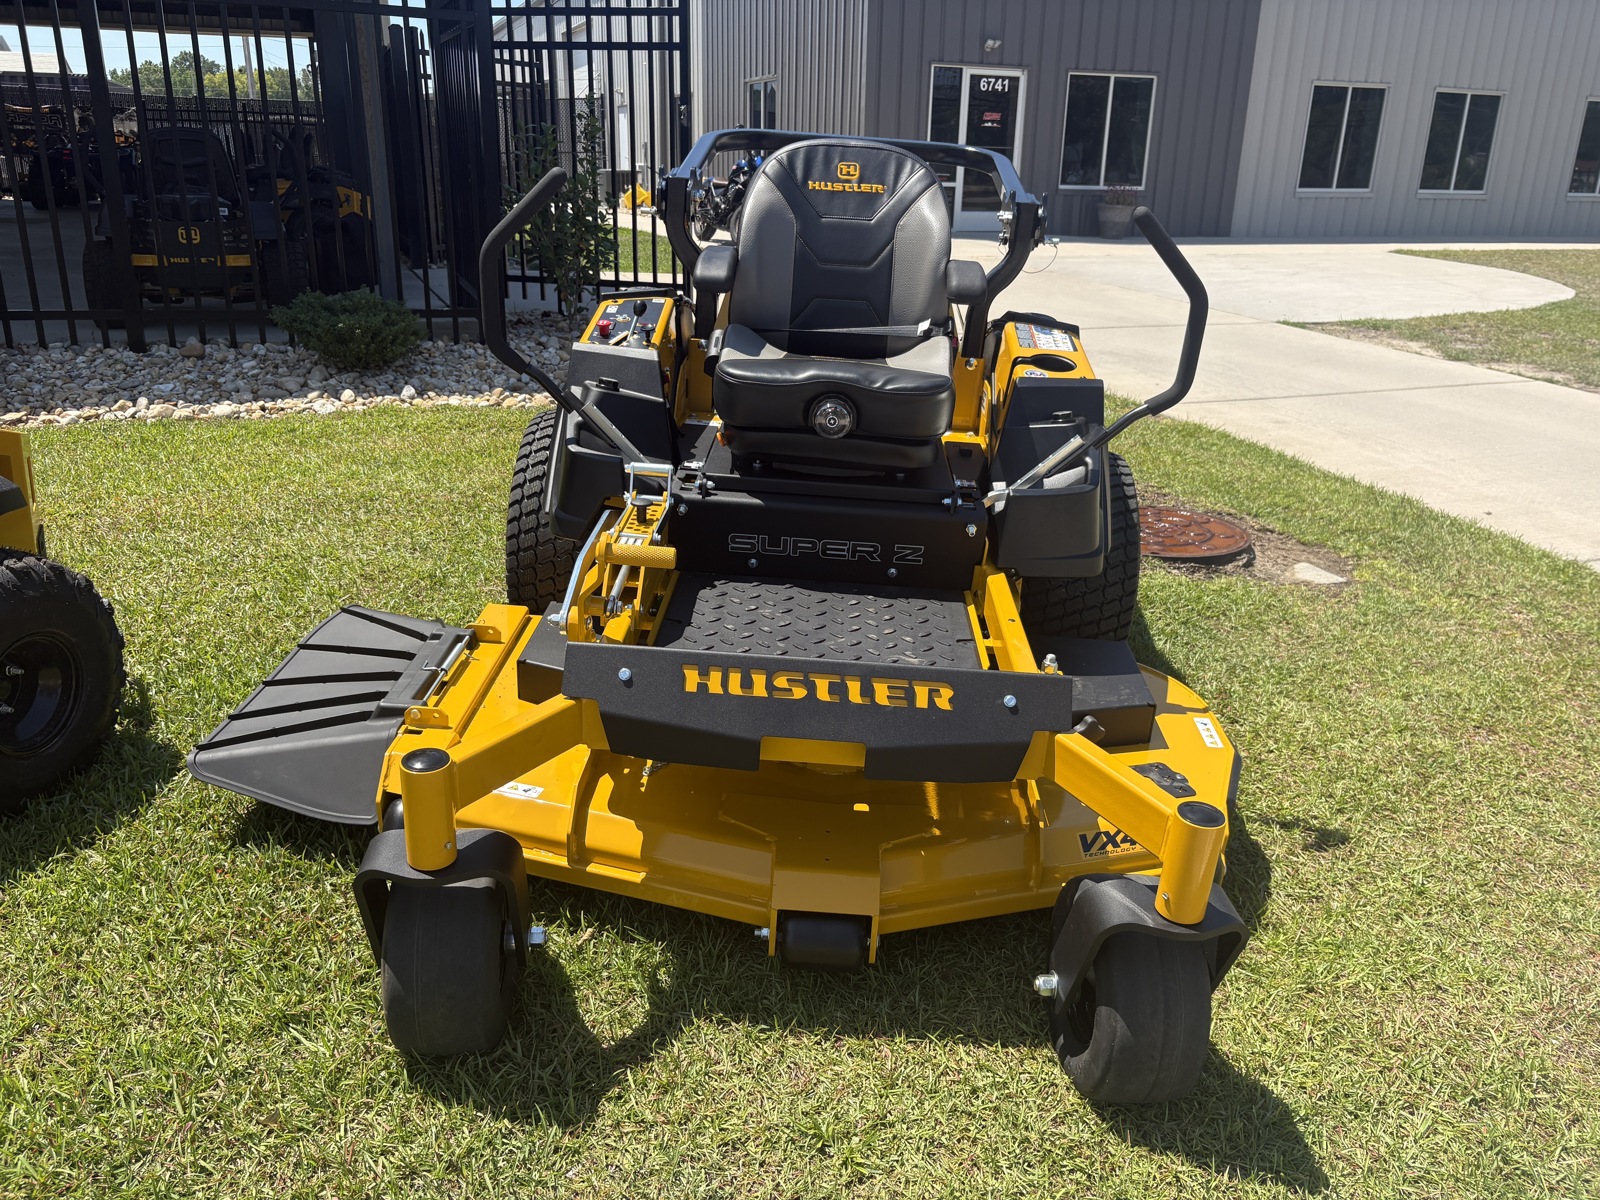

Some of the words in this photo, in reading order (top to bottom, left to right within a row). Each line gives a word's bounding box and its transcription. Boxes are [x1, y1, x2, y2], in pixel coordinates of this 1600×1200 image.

[980, 77, 1009, 92] 6741
[807, 180, 885, 194] HUSTLER
[728, 533, 881, 562] SUPER
[893, 544, 925, 565] Z
[681, 664, 954, 711] HUSTLER
[1083, 846, 1137, 858] TECHNOLOGY
